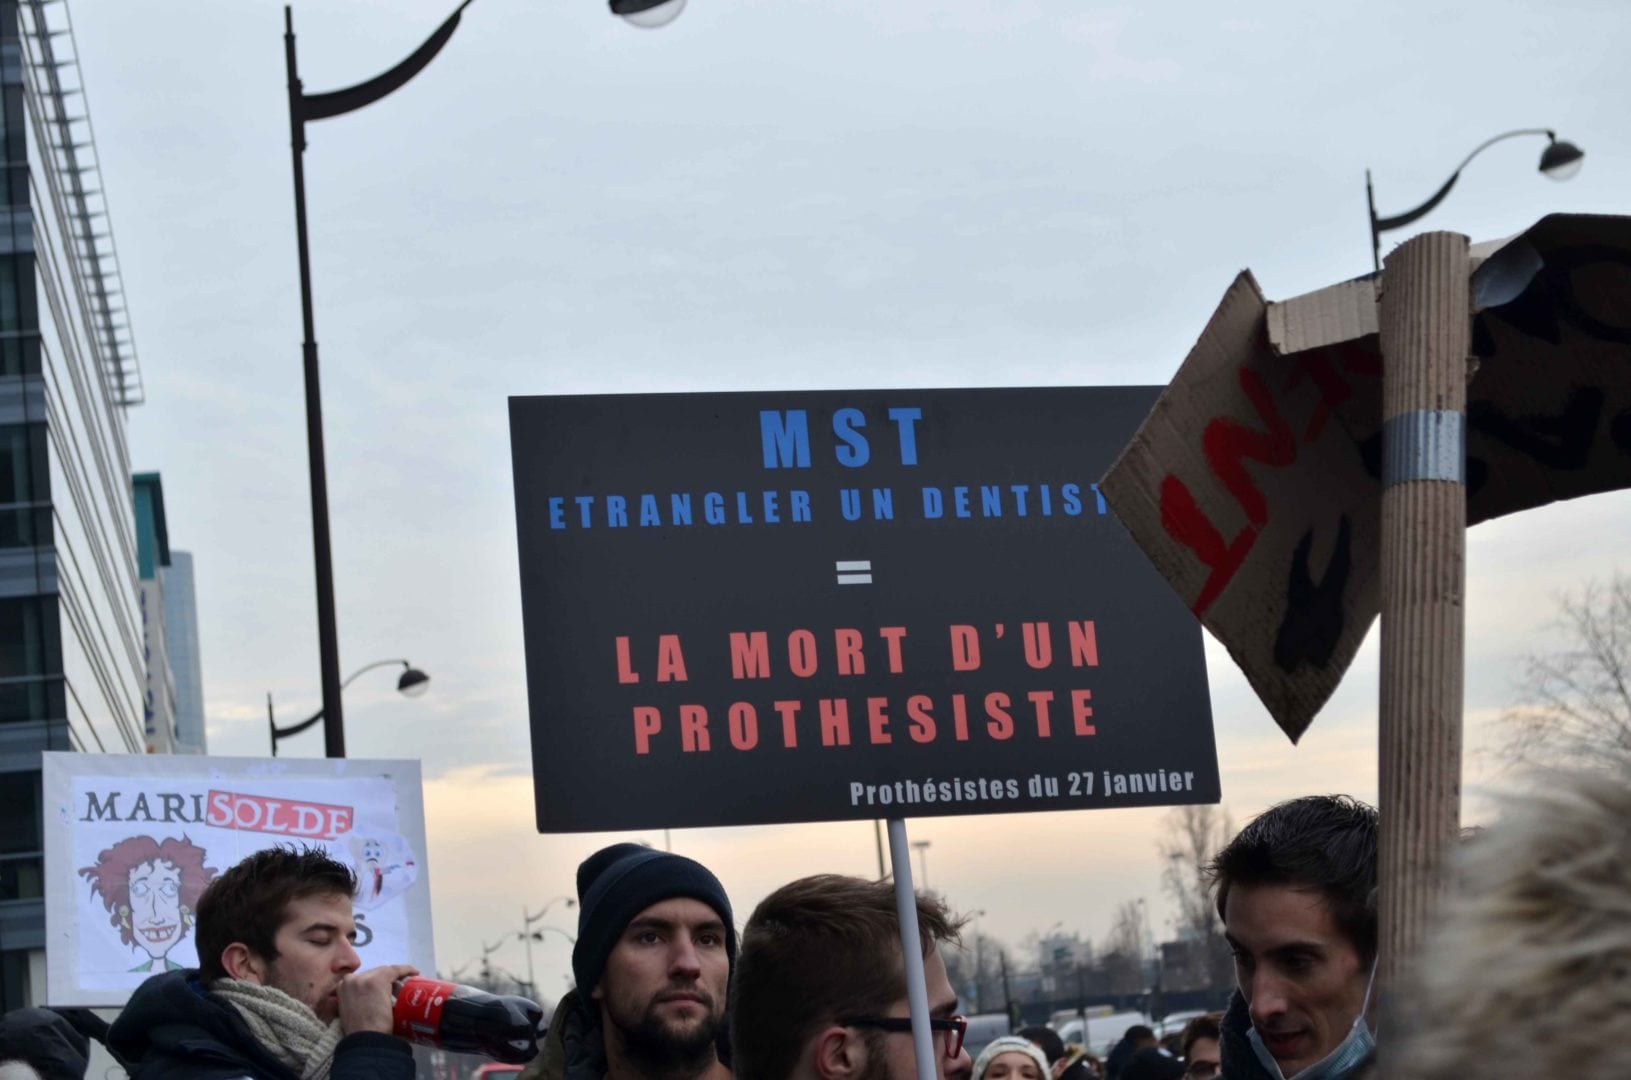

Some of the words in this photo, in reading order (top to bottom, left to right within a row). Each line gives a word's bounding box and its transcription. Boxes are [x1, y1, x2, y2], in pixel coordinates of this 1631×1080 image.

[759, 407, 922, 469] MST
[548, 489, 813, 529] ETRANGLER
[840, 488, 893, 521] UN
[922, 483, 1108, 519] DENTIST
[616, 635, 688, 684] LA
[729, 625, 907, 679] MORT
[950, 620, 1099, 672] D'UN
[633, 689, 1096, 754] PROTHESISTE
[850, 777, 1019, 806] Prothésistes
[1028, 774, 1059, 798] du
[1067, 771, 1094, 796] 27
[1103, 768, 1194, 797] janvier
